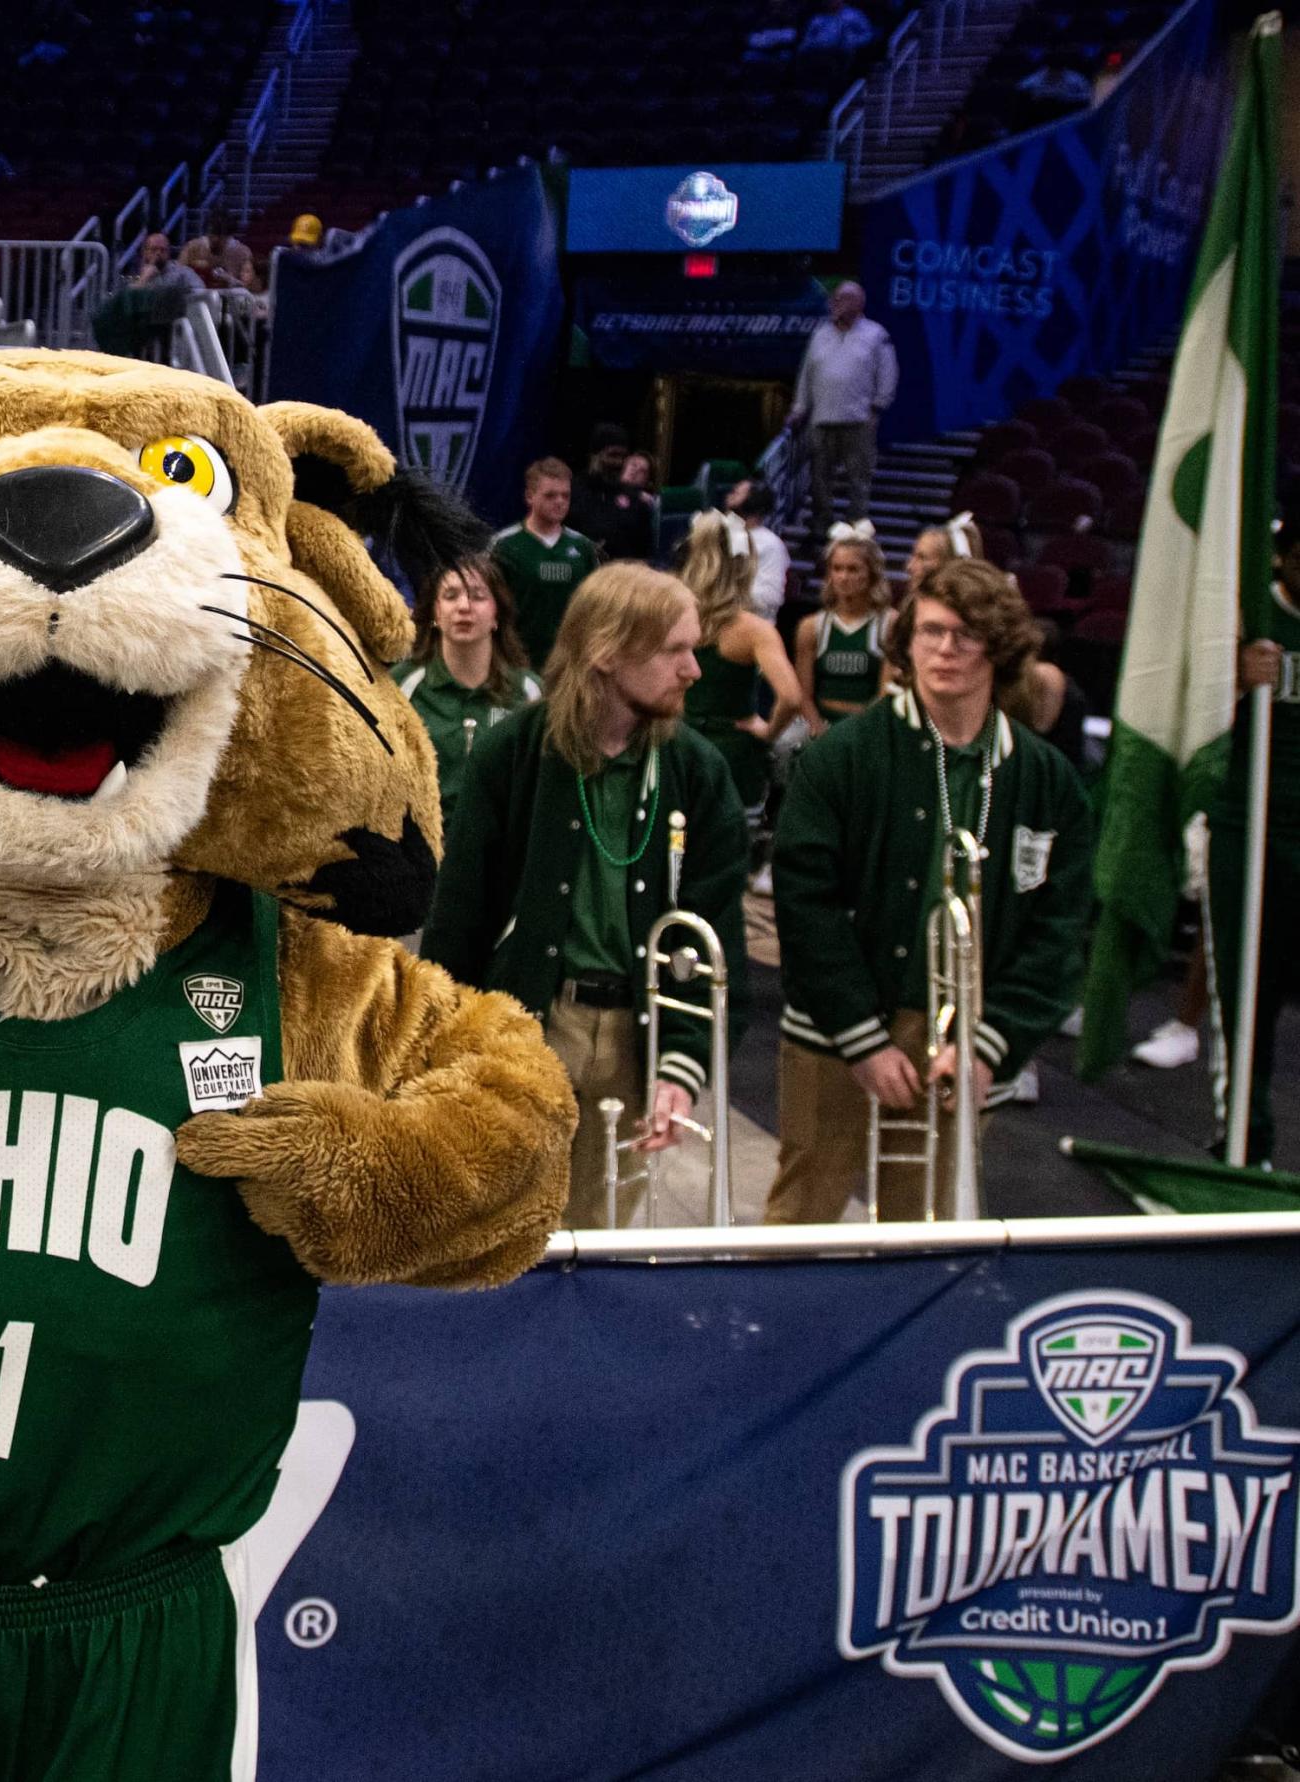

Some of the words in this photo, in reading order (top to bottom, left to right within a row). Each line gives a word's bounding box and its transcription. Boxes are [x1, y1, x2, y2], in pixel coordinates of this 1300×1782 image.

[892, 239, 1061, 281] COMCAST
[892, 275, 1053, 318] BUSINESS
[400, 336, 488, 410] MAC
[191, 991, 241, 1009] MAC
[193, 1062, 254, 1082] UNIVERSITY
[196, 1078, 253, 1096] COURTYARD
[1043, 1358, 1151, 1389] MAC
[967, 1453, 1029, 1484] MAC
[869, 1469, 1293, 1629] TOURNAMENT
[1019, 1588, 1082, 1602] presented
[1084, 1589, 1103, 1603] by
[960, 1605, 1051, 1632] Credit
